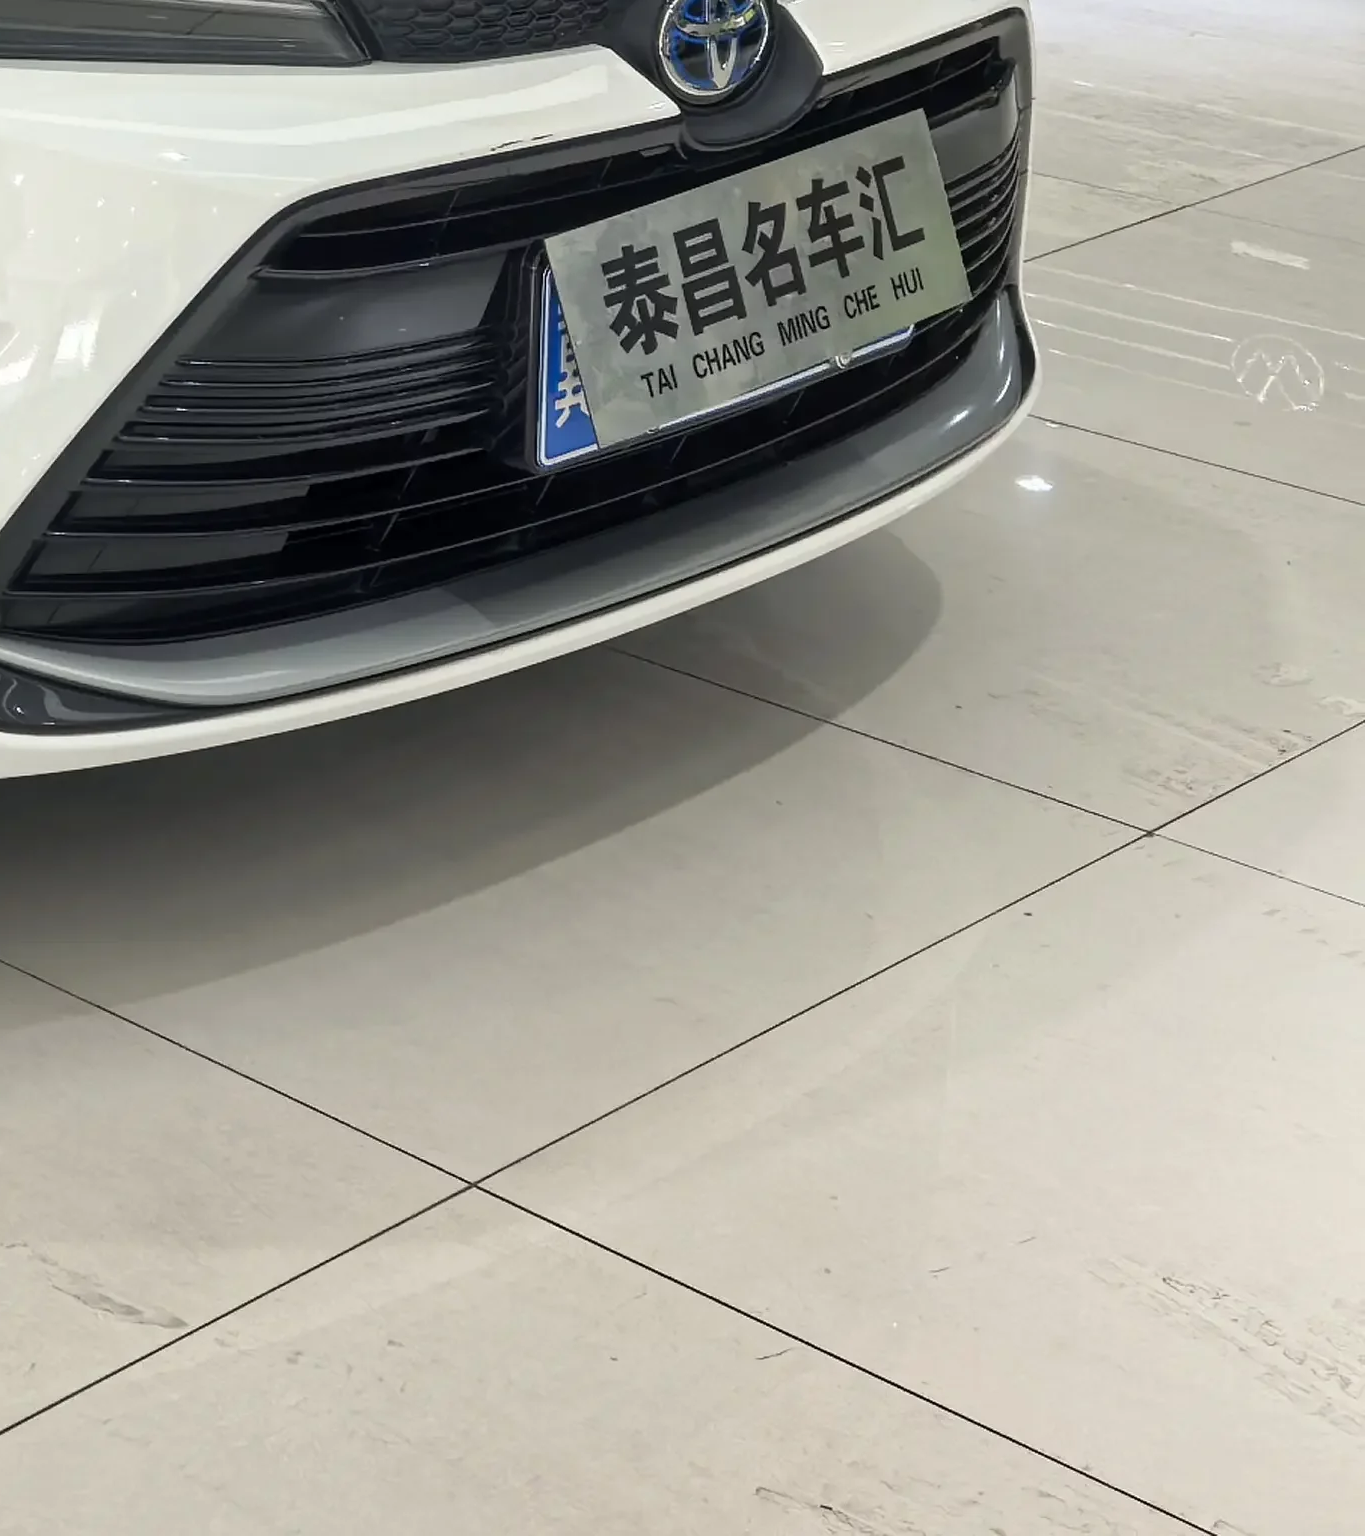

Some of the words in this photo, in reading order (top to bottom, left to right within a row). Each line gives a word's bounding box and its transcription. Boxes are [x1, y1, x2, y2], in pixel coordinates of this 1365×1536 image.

[600, 155, 926, 356] 泰昌名车汇
[640, 364, 678, 399] TAI
[692, 331, 766, 379] CHANG
[777, 305, 831, 347] MING
[843, 285, 881, 319] CHE
[890, 267, 925, 301] HUI
